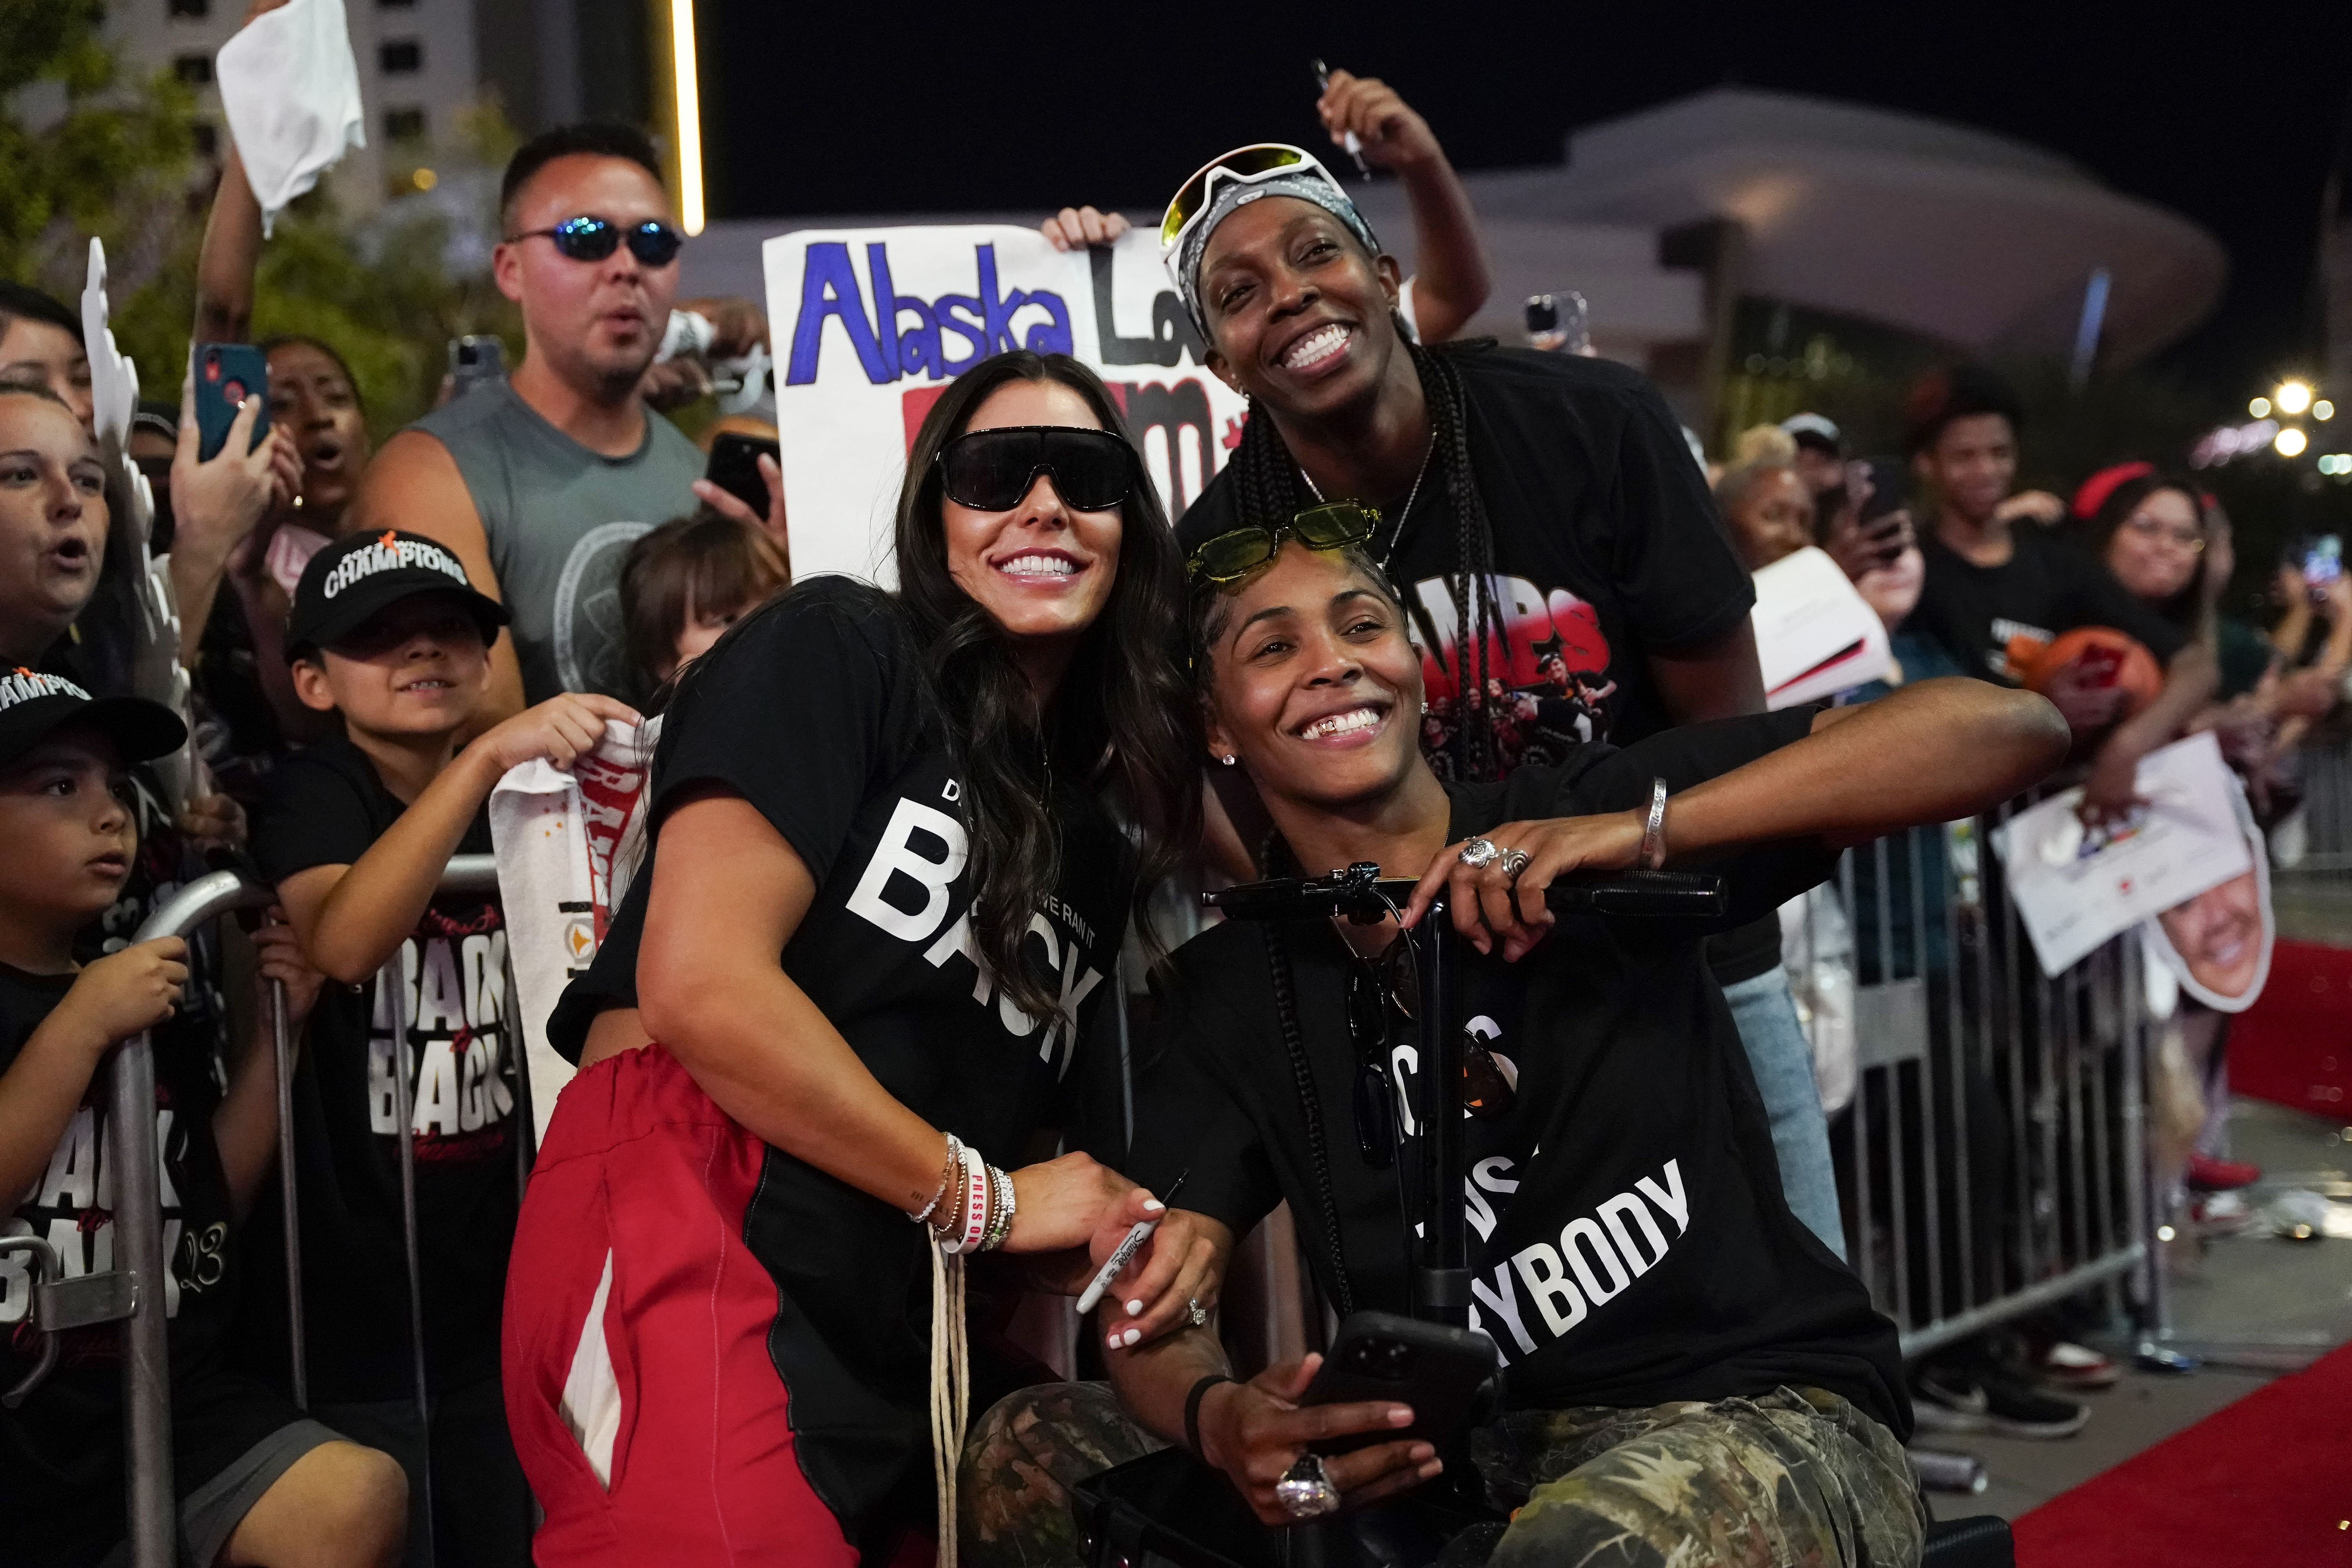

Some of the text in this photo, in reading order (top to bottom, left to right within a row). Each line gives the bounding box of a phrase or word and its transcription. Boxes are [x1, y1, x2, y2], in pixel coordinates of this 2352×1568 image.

[786, 241, 1207, 386] Alaska La
[324, 545, 468, 599] CHAMPIONS
[1063, 903, 1086, 940] RAN
[1086, 927, 1095, 949] IT
[966, 1175, 984, 1243] PRESS ON
[1005, 1175, 1015, 1213] AUNTIE
[180, 1220, 227, 1294] 23
[1113, 1230, 1145, 1267] Sharpie
